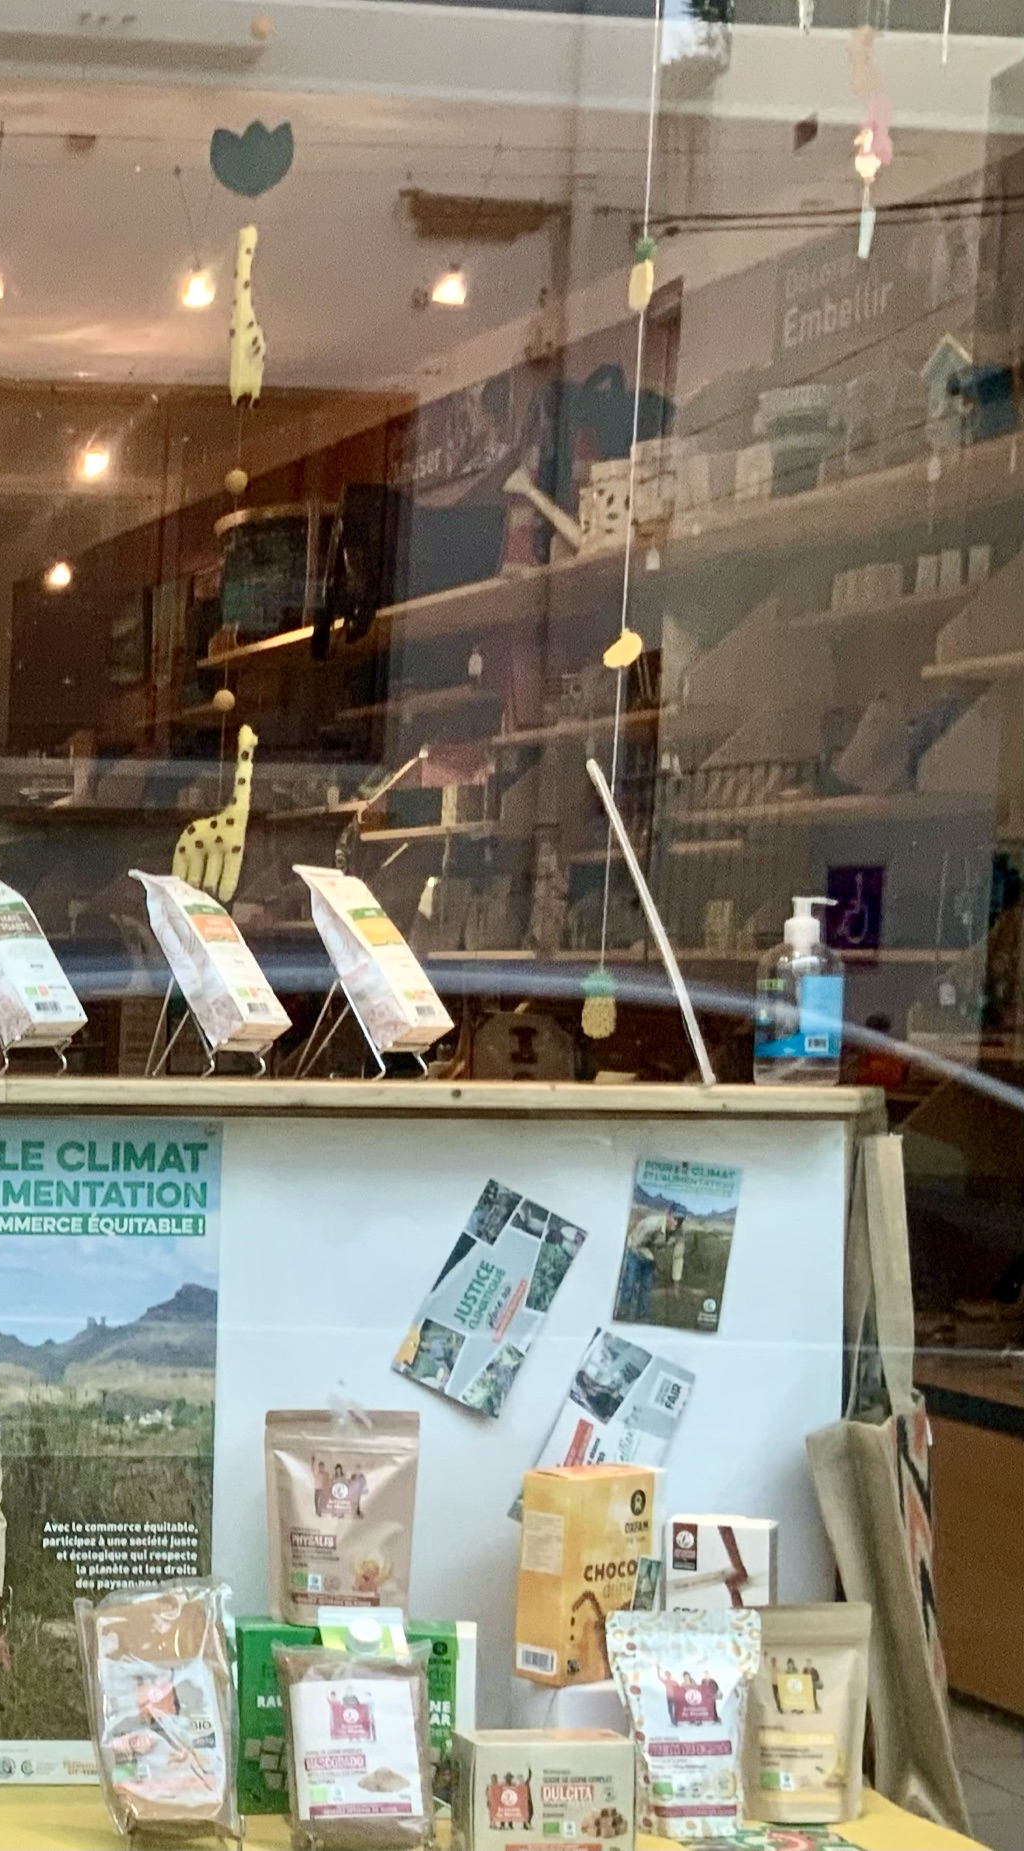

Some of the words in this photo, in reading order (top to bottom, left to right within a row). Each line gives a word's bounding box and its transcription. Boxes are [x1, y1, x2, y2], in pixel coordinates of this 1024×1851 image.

[56, 1140, 209, 1173] CLIMAT
[87, 1213, 193, 1235] ÉQUITABLE
[453, 1259, 496, 1325] JUSTICE
[43, 1522, 70, 1533] Avec
[71, 1521, 83, 1533] le
[84, 1522, 142, 1533] commerce
[143, 1521, 199, 1536] équitable,
[42, 1535, 97, 1549] participez
[107, 1536, 127, 1547] une
[170, 1535, 198, 1548] juste
[56, 1550, 68, 1561] et
[69, 1549, 128, 1564] écologique
[130, 1549, 148, 1564] qui
[149, 1551, 198, 1563] respecte
[75, 1563, 87, 1575] la
[88, 1563, 130, 1577] planète
[131, 1564, 143, 1575] et
[145, 1563, 162, 1575] les
[164, 1563, 198, 1576] droits
[583, 1559, 638, 1582] CHOCO
[75, 1578, 95, 1589] des
[542, 1785, 593, 1801] DULCITA
